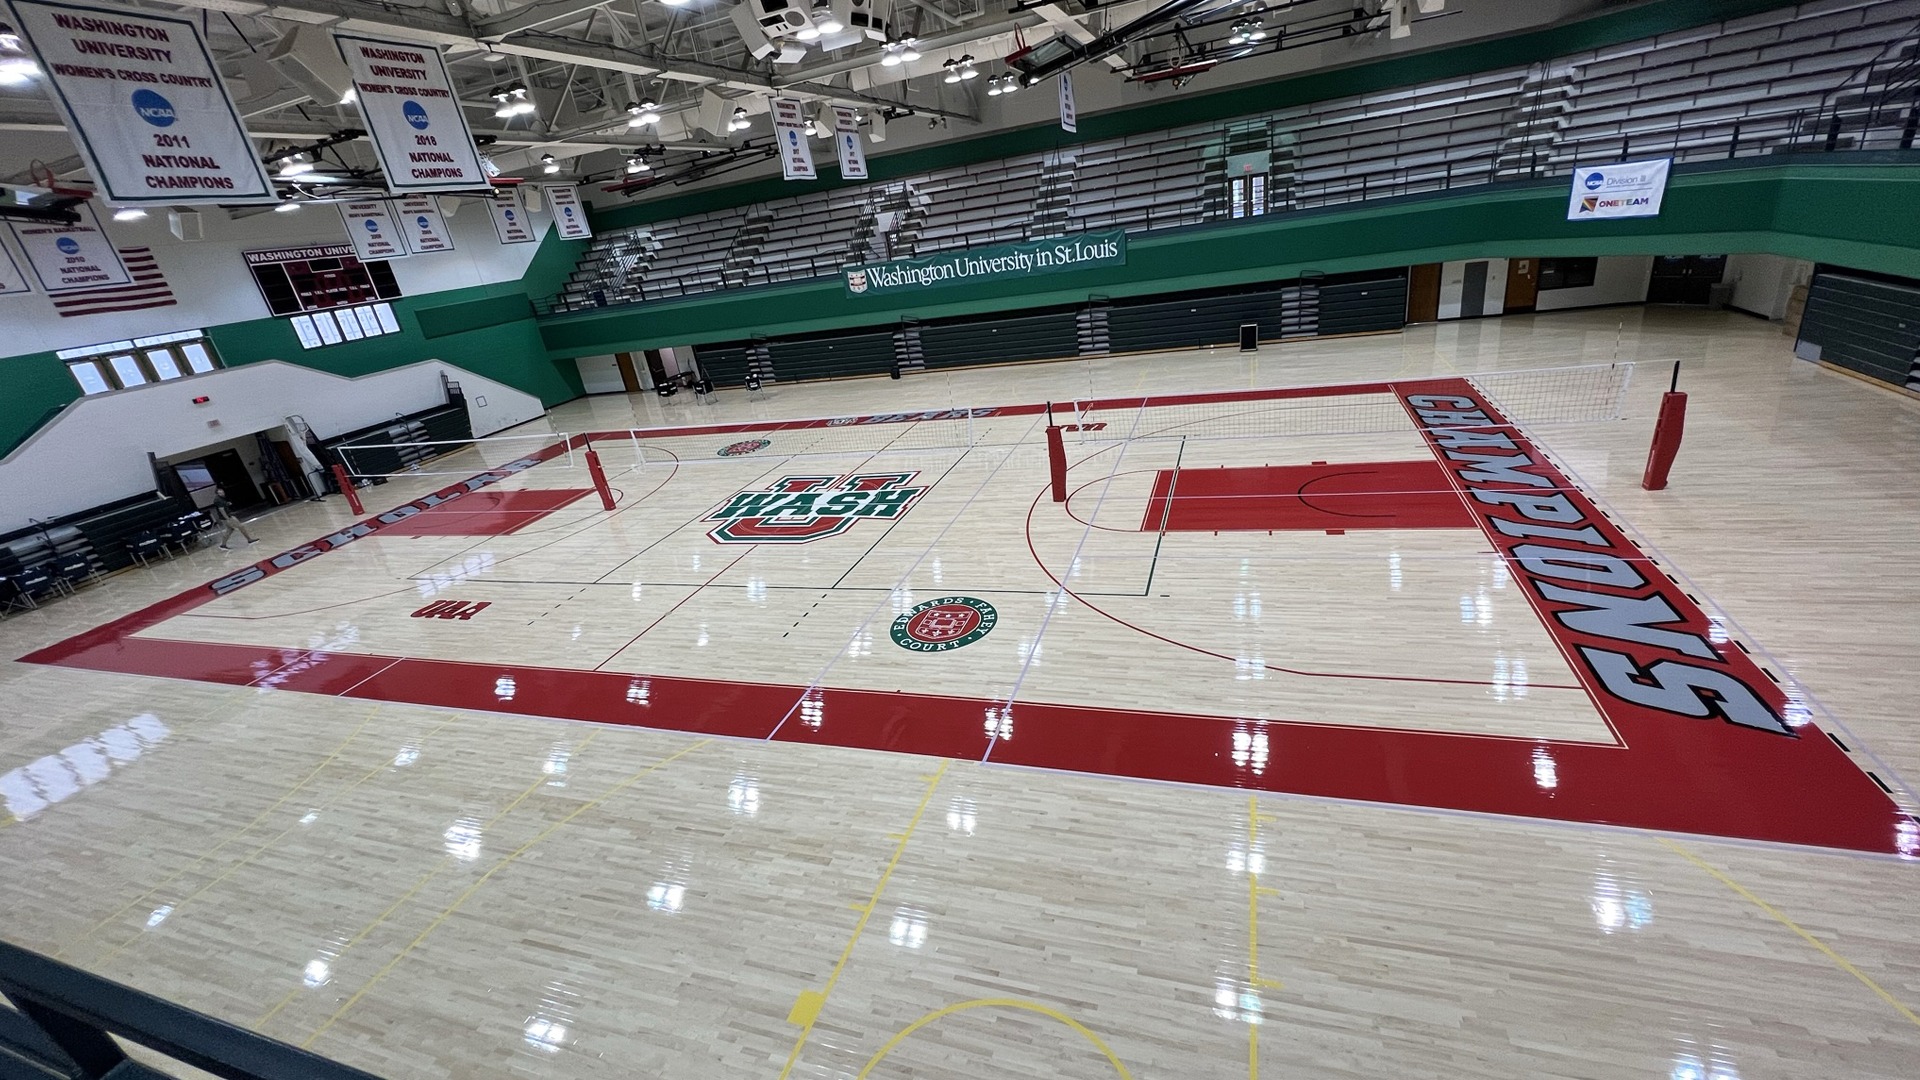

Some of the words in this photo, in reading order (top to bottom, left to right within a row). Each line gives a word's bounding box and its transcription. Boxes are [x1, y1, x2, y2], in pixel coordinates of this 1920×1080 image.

[51, 13, 169, 43] WASHINGTON
[72, 39, 172, 63] UNIVERSITY
[359, 46, 425, 64] WASHINGTON
[51, 63, 116, 80] WOMEN'S
[119, 69, 158, 84] CROSS
[163, 73, 214, 88] COUNTRY
[370, 65, 428, 81] UNIVERSITY
[358, 82, 394, 94] WOMEN'S
[394, 85, 417, 96] CROSS
[417, 88, 450, 98] COUNTRY
[140, 106, 176, 118] NCAA
[406, 113, 430, 124] NCAA
[153, 134, 190, 149] 2011
[415, 135, 437, 146] 2018
[142, 154, 221, 170] NATIONAL
[409, 152, 454, 163] NATIONAL
[411, 167, 463, 179] CHAMPIONS
[1606, 176, 1638, 186] Division
[146, 175, 234, 190] CHAMPIONS
[1598, 197, 1649, 207] ONETEAM
[247, 246, 323, 262] WASHINGTON
[325, 245, 356, 256] UNIVE
[60, 265, 101, 274] NATIONAL
[866, 262, 957, 289] Washington
[955, 251, 1034, 279] University
[1036, 248, 1054, 268] in
[61, 274, 110, 284] CHAMPIONS
[706, 487, 928, 520] WASH
[1405, 393, 1802, 740] CHAMPIONS
[410, 600, 492, 620] UAA
[894, 597, 965, 631] EDWARDS
[975, 601, 995, 635] FAHEY
[899, 637, 960, 652] COURT
